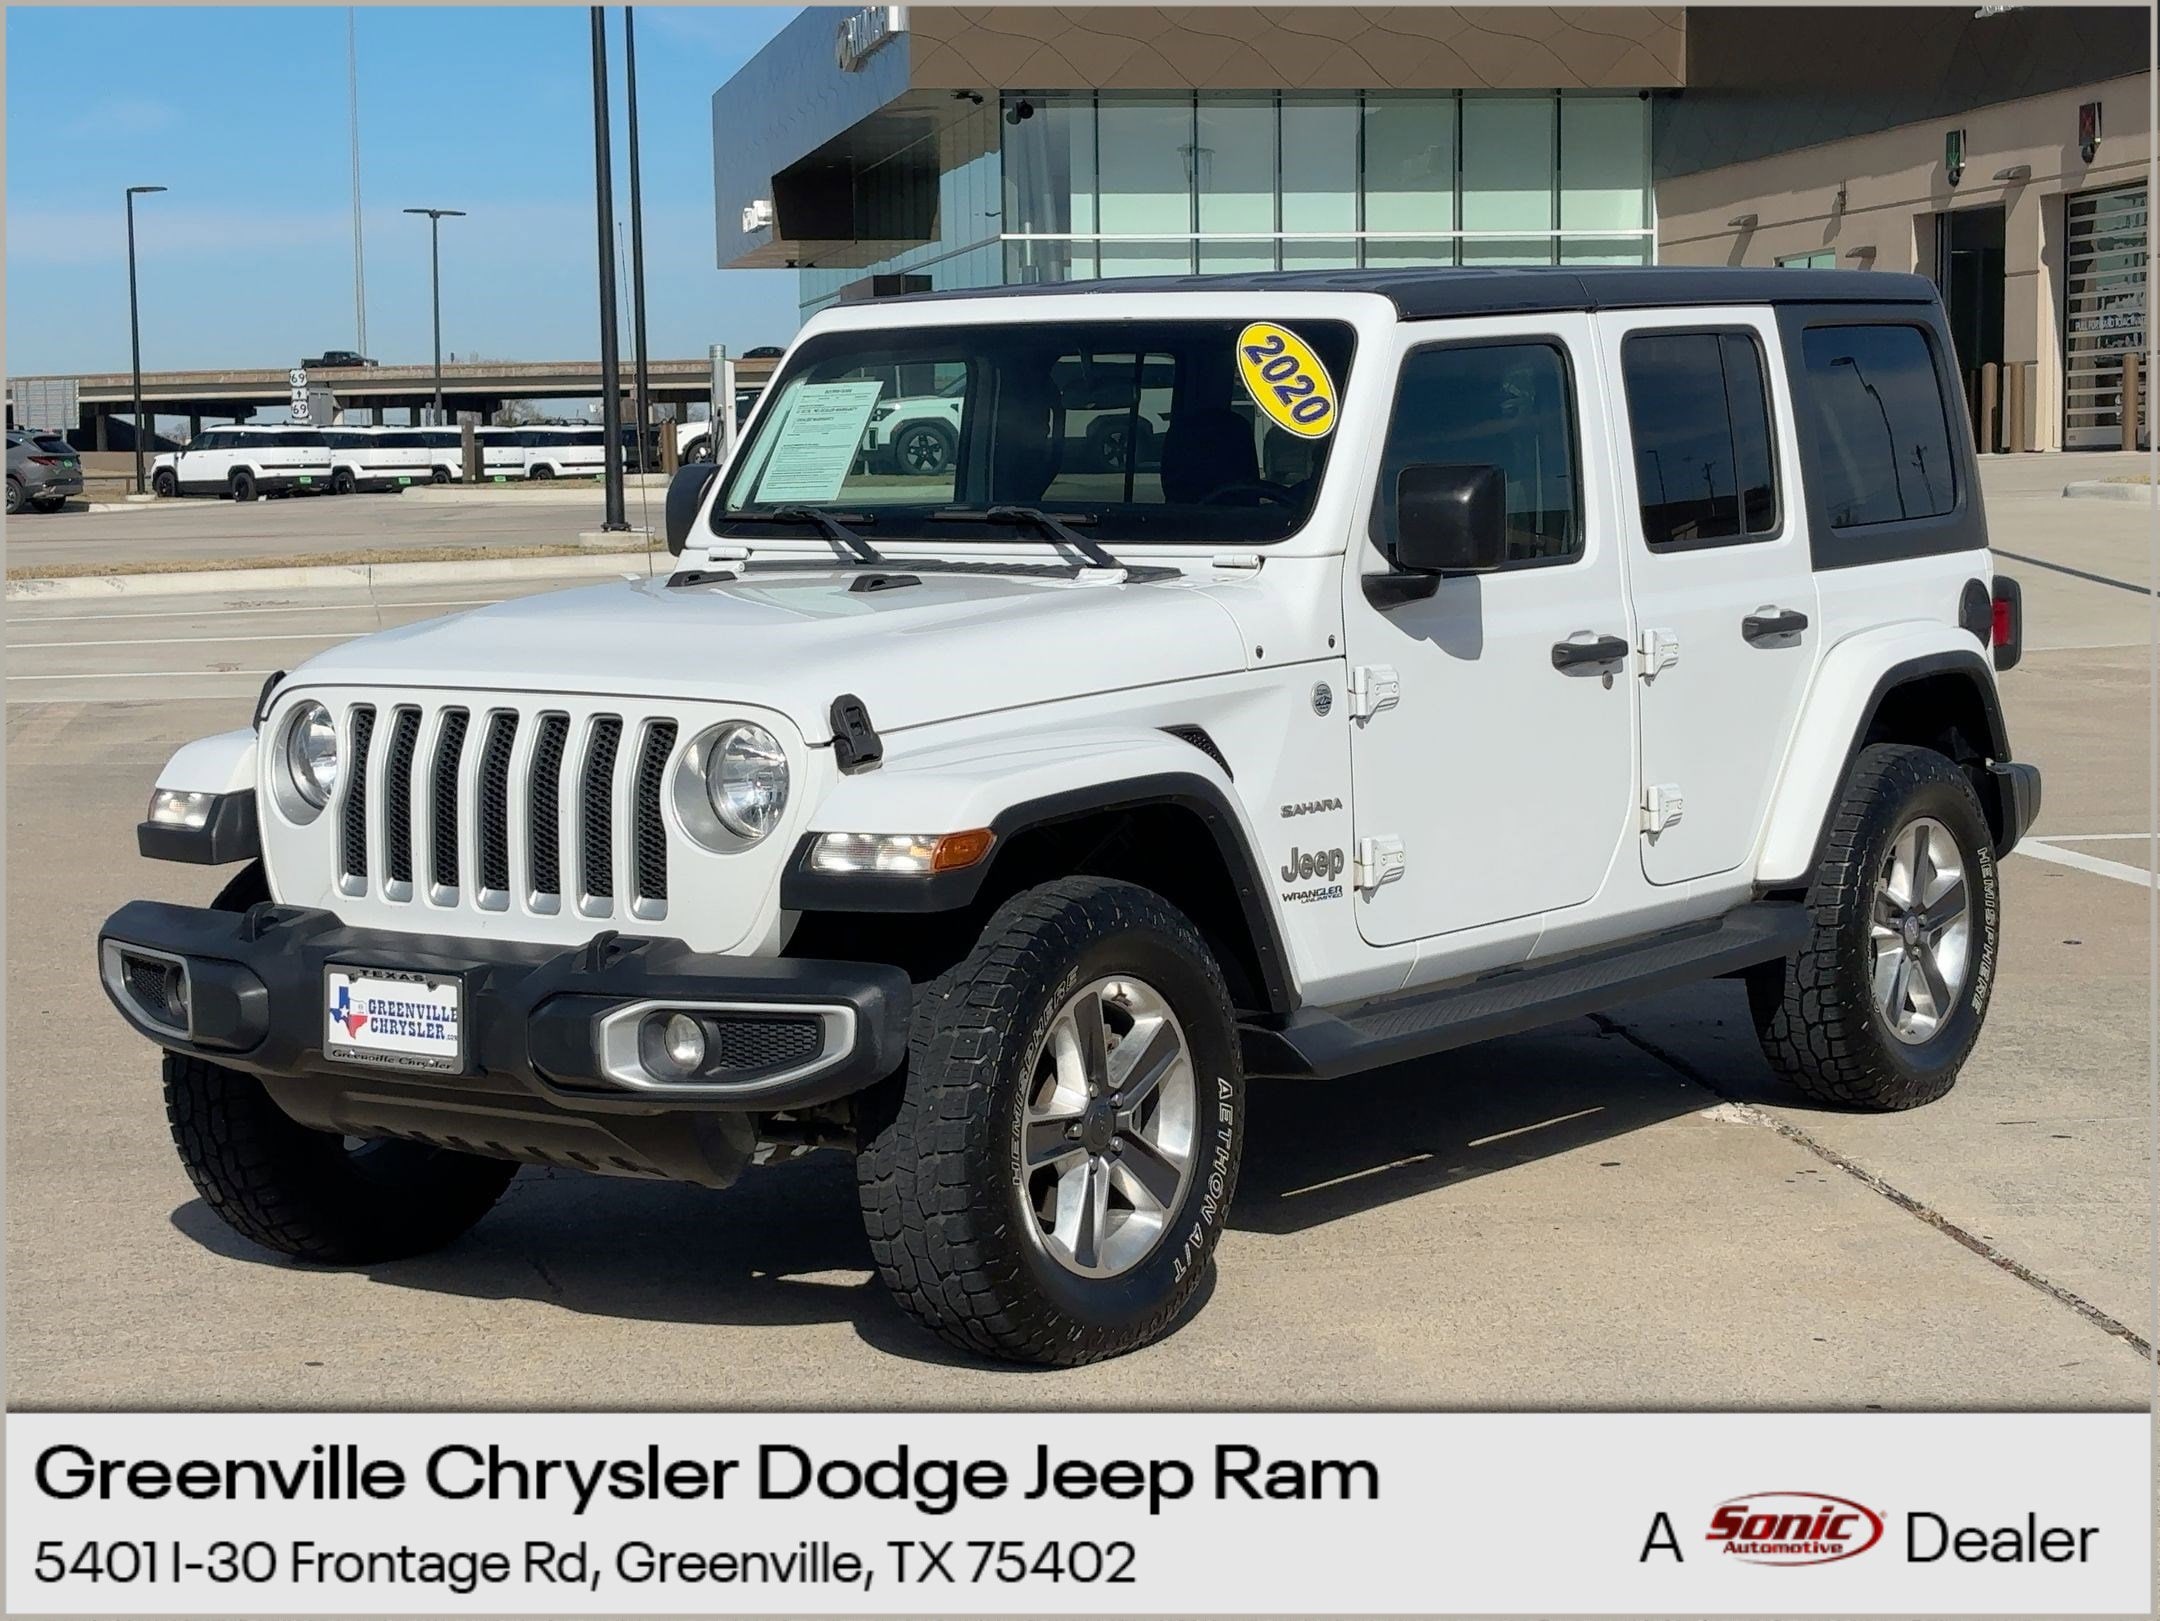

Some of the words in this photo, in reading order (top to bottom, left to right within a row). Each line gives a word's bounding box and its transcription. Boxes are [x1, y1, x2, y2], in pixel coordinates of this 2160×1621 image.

[291, 373, 305, 383] 69
[1242, 335, 1331, 425] 2020
[293, 404, 307, 414] 69
[1280, 798, 1343, 818] SAHARA
[1281, 847, 1344, 883] Jeep
[1282, 885, 1343, 902] WRANGLER
[1971, 846, 1997, 1016] HEMISPHERE
[359, 969, 426, 982] TEXAS
[368, 998, 457, 1022] GREENVILLE
[370, 1017, 445, 1040] CHRYSLER
[332, 1049, 395, 1064] Greenville
[398, 1055, 452, 1070] Chrysler
[1201, 1077, 1234, 1226] AETHON
[1173, 1221, 1205, 1284] A/T
